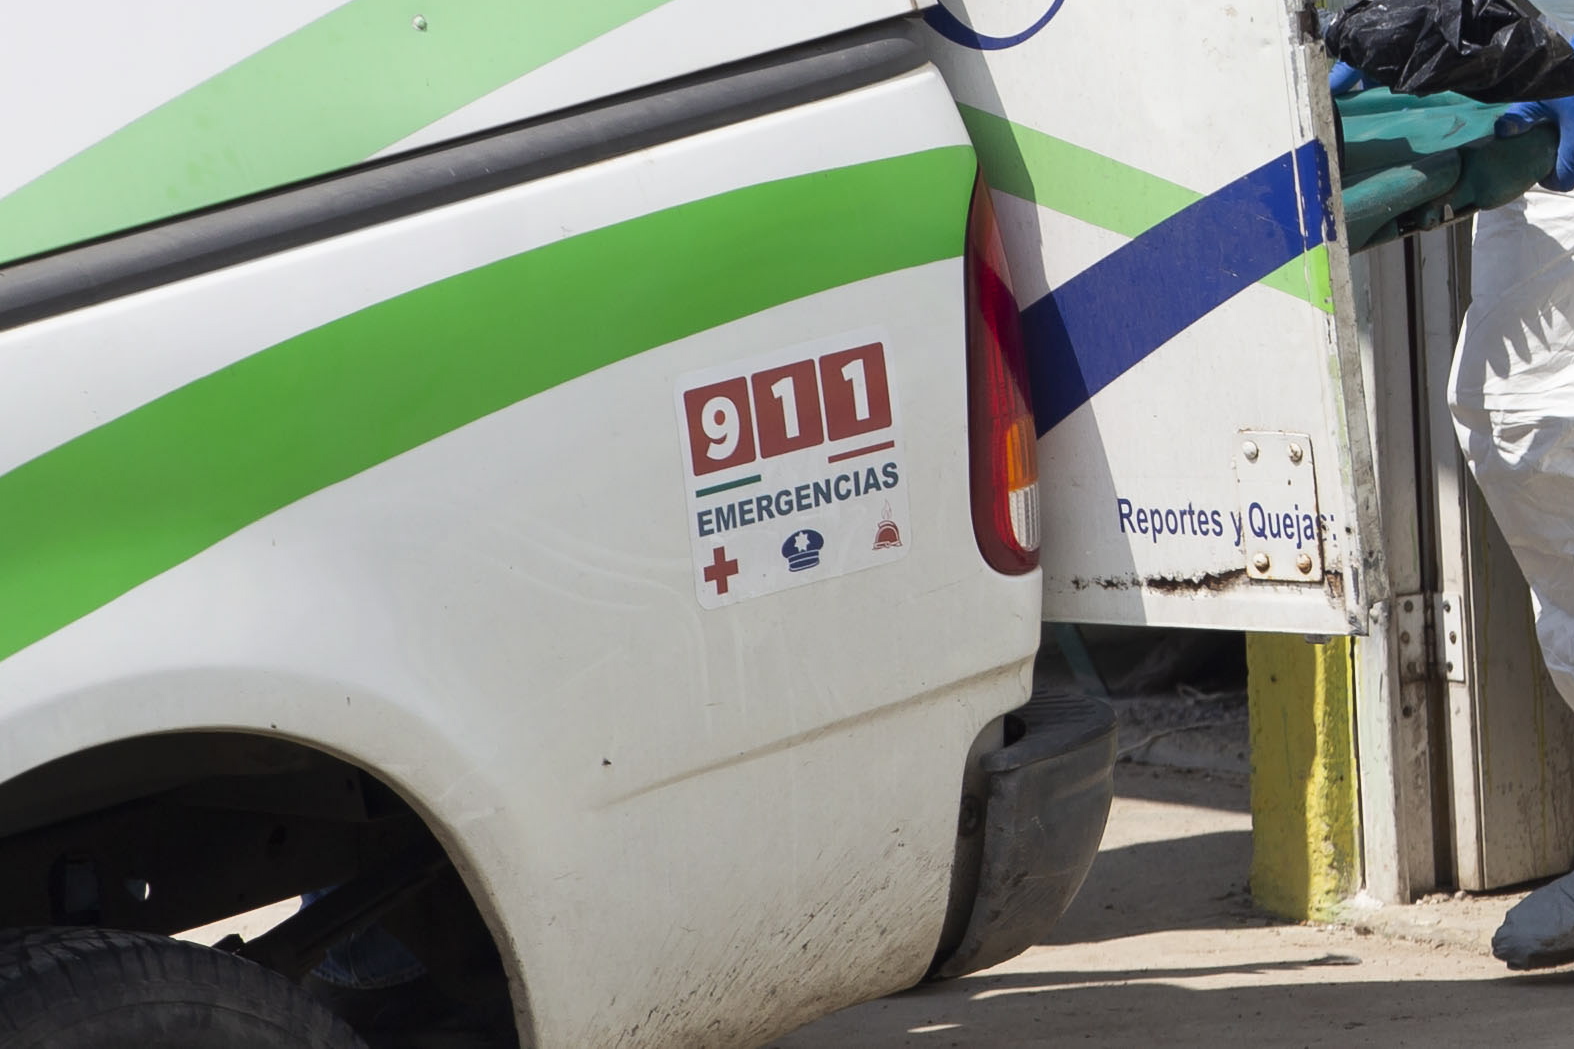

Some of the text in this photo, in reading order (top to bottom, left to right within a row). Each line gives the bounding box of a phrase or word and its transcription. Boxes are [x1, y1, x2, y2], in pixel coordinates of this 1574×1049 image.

[701, 358, 871, 461] 911
[697, 462, 899, 537] EMERGENCIAS
[1117, 498, 1223, 543] Reportes
[1230, 509, 1242, 547] y
